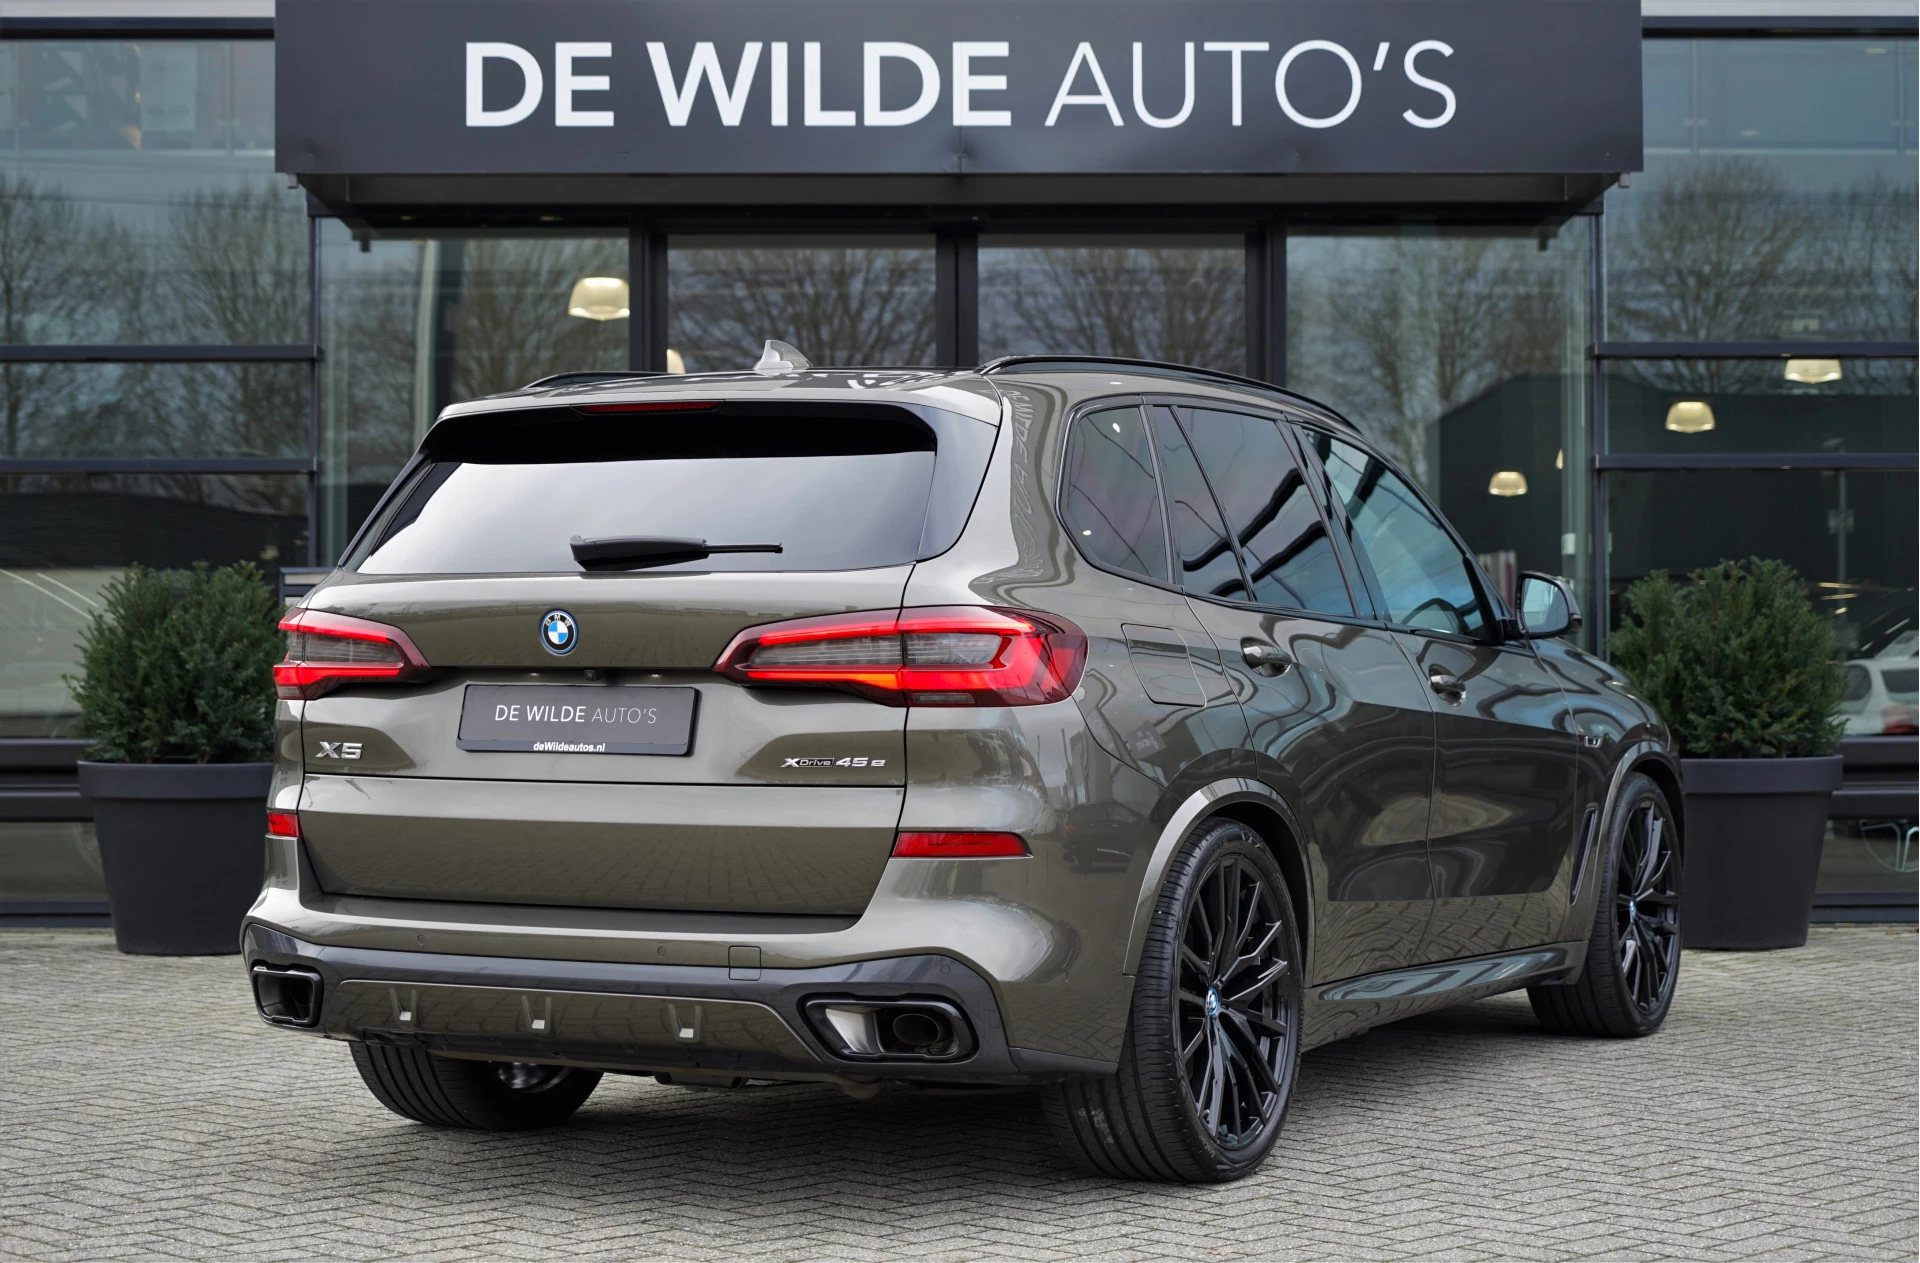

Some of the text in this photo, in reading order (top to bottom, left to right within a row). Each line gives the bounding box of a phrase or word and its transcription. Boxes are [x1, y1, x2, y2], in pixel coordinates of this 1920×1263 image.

[466, 40, 1457, 128] DE WILDE AUTO'S
[494, 704, 657, 724] DE WILDE AUTO'S
[315, 741, 363, 760] X5
[533, 741, 606, 753] deWildeautos.nl
